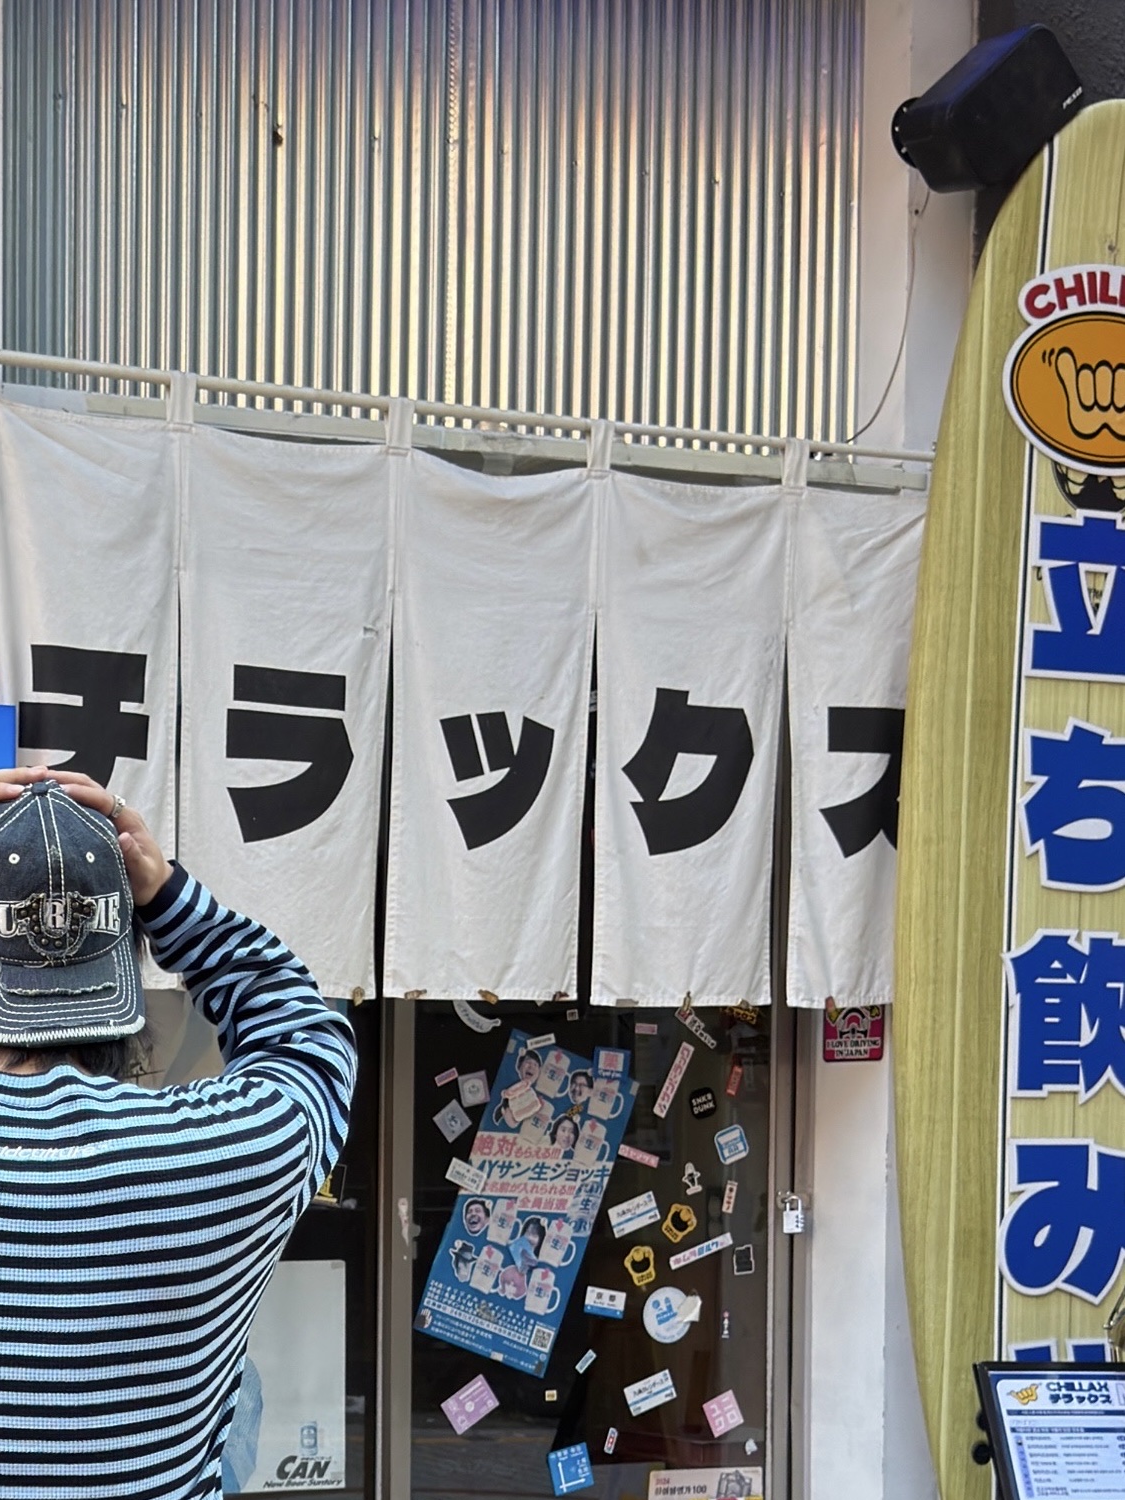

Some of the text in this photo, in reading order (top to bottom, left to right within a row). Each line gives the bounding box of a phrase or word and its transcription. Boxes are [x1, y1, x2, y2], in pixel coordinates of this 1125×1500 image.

[18, 644, 905, 858] チラックス
[831, 1040, 848, 1048] LOVE
[850, 1039, 880, 1048] DRIVING
[846, 1049, 868, 1057] JAPAN
[693, 1102, 715, 1114] DUNK
[1046, 1382, 1109, 1392] CHILLAX
[1049, 1393, 1112, 1404] チラックス
[276, 1455, 331, 1480] CAN
